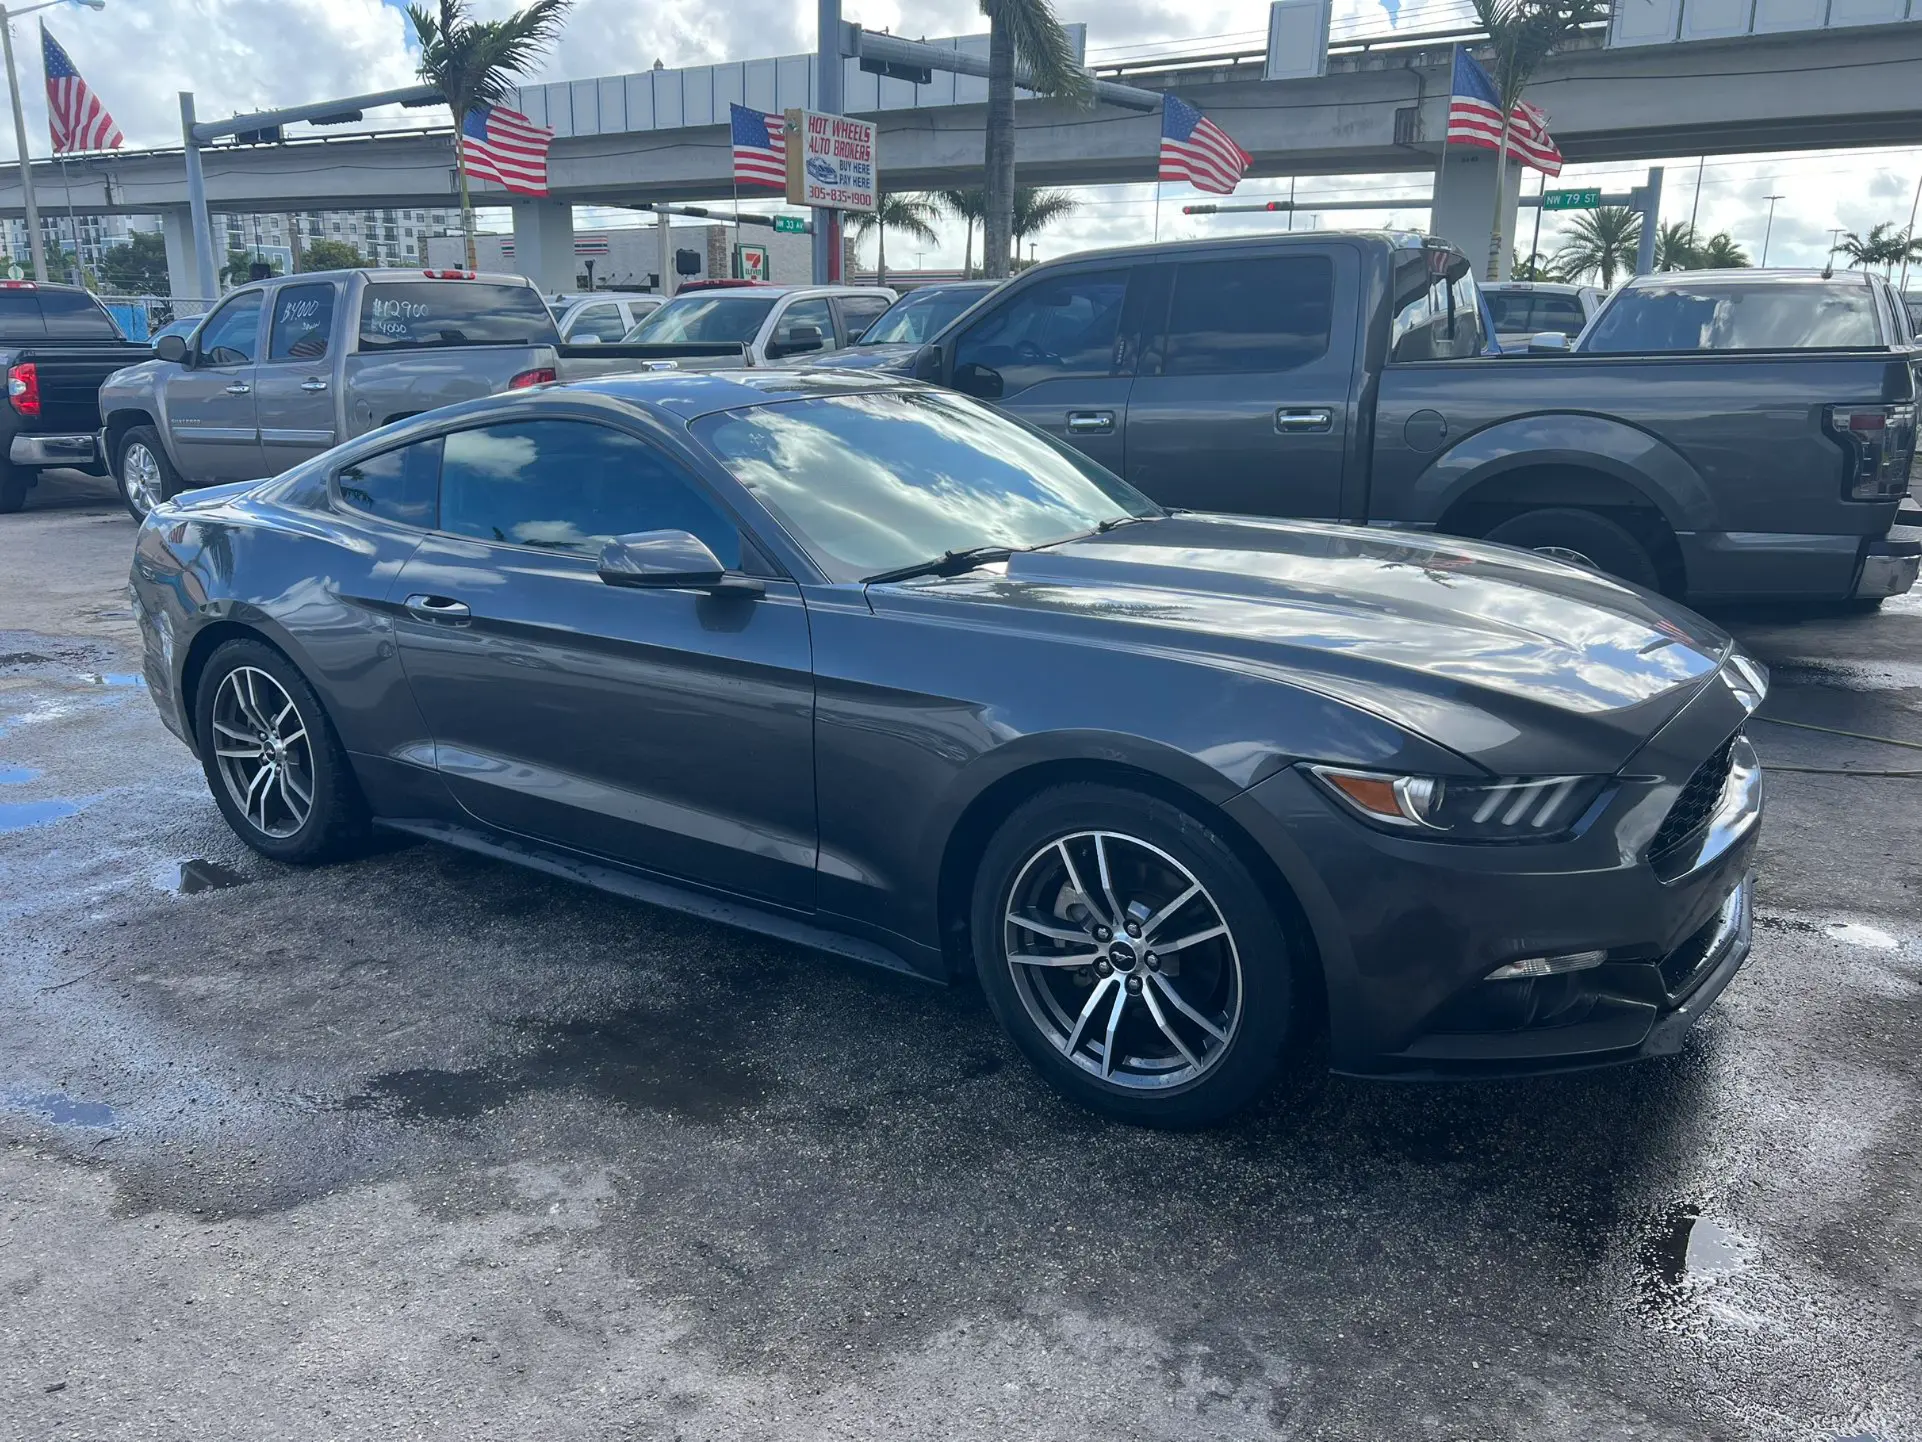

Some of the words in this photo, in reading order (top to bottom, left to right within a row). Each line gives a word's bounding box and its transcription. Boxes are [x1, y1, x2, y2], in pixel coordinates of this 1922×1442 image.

[808, 116, 828, 135] HOT
[832, 120, 871, 143] WHEELS
[808, 136, 830, 155] AUTO
[833, 140, 871, 161] BROKERS
[839, 160, 852, 172] BUY
[853, 163, 871, 175] HERE
[839, 174, 852, 185] PAY
[852, 177, 871, 189] HERE
[809, 186, 872, 206] 305-835-1900
[1546, 195, 1561, 205] NW
[1565, 193, 1580, 205] 79
[1584, 193, 1596, 203] ST
[786, 220, 794, 229] 33
[745, 253, 761, 268] 7
